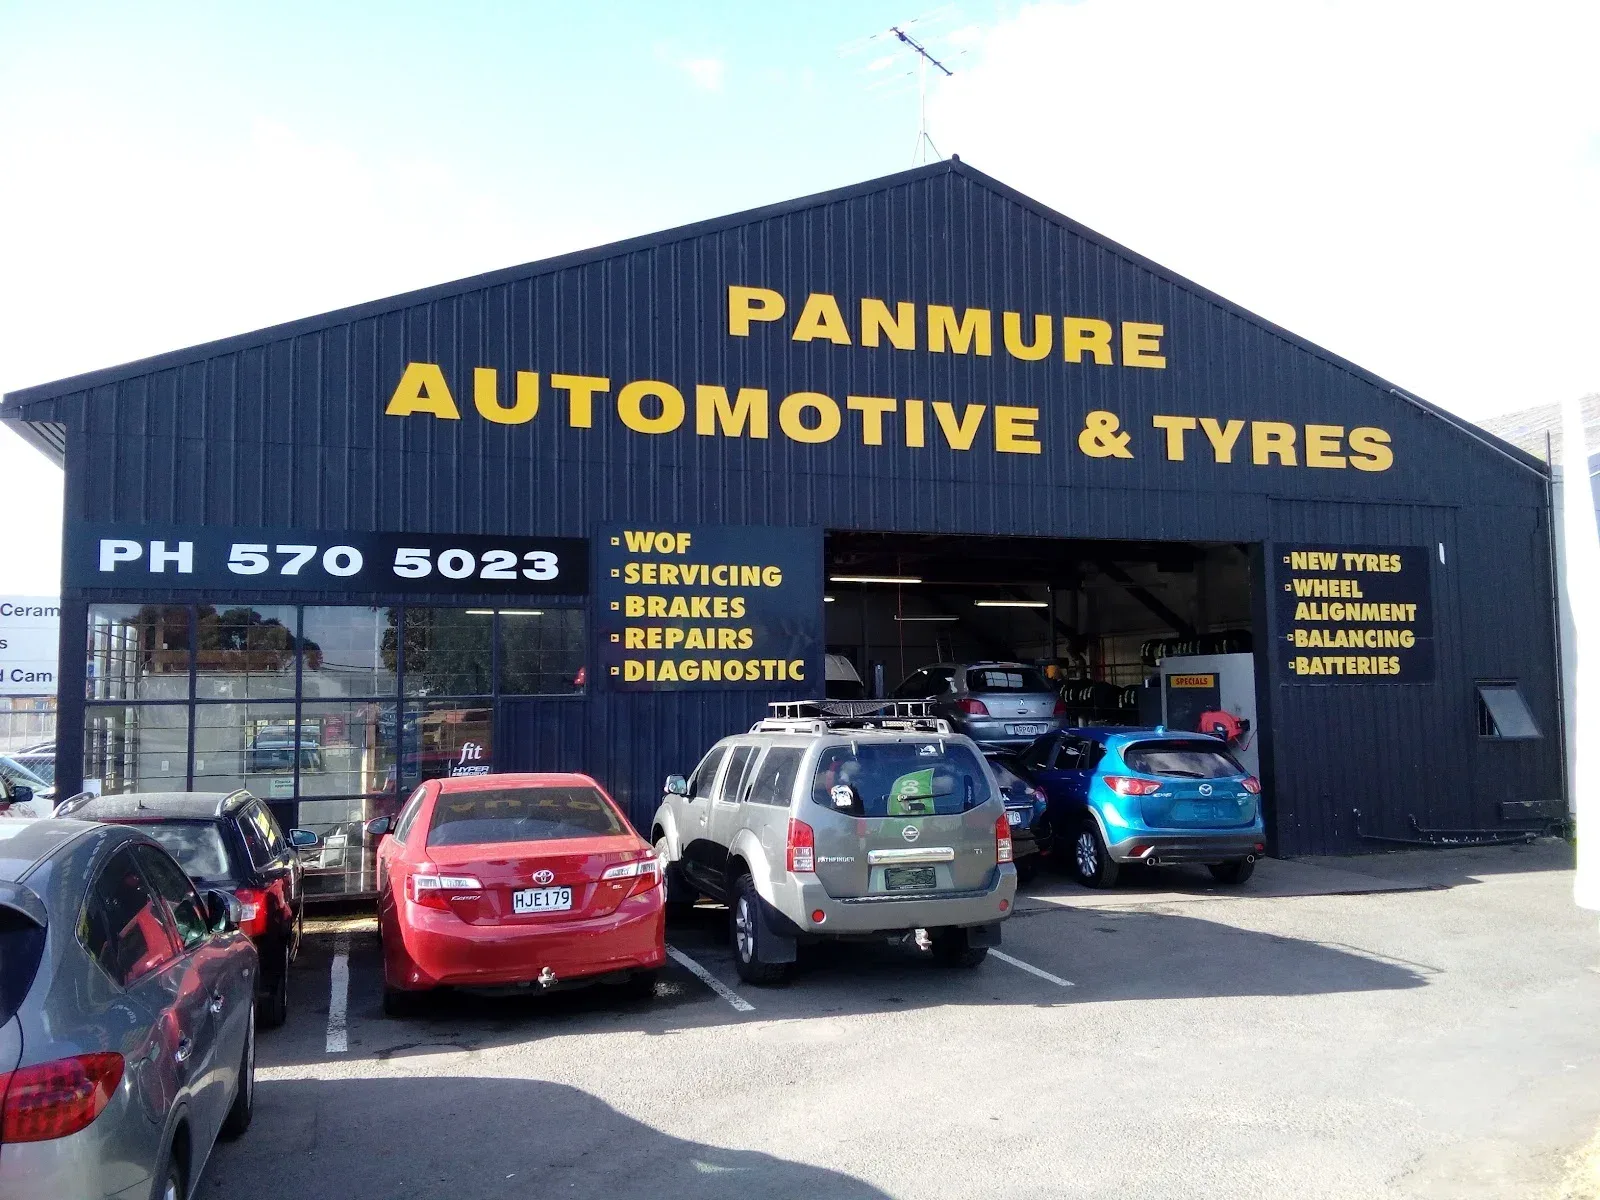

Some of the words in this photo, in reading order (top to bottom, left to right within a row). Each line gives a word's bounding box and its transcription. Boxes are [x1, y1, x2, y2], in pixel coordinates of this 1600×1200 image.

[728, 285, 1167, 369] PANMURE
[385, 362, 1042, 454] AUTOMOTIVE
[1078, 410, 1135, 459] &
[1151, 414, 1394, 472] TYRES
[623, 531, 692, 554] WOF
[99, 539, 194, 574] PH
[227, 543, 364, 577] 570
[393, 547, 560, 581] 5023
[1290, 551, 1339, 571] NEW
[1341, 552, 1402, 573] TYRES
[624, 562, 783, 587] SERVICING
[1292, 578, 1364, 599] WHEEL
[0, 602, 60, 617] Ceram
[625, 595, 746, 619] BRAKES
[1294, 602, 1417, 622] ALIGNMENT
[625, 627, 754, 650] REPAIRS
[1294, 629, 1416, 649] BALANCING
[10, 668, 53, 683] Cam
[624, 659, 805, 682] DIAGNOSTIC
[1296, 656, 1401, 676] BATTERIES
[1175, 677, 1208, 686] SPECIALS
[458, 742, 483, 765] fit
[452, 765, 490, 773] HYPER
[515, 890, 570, 908] HJE179
